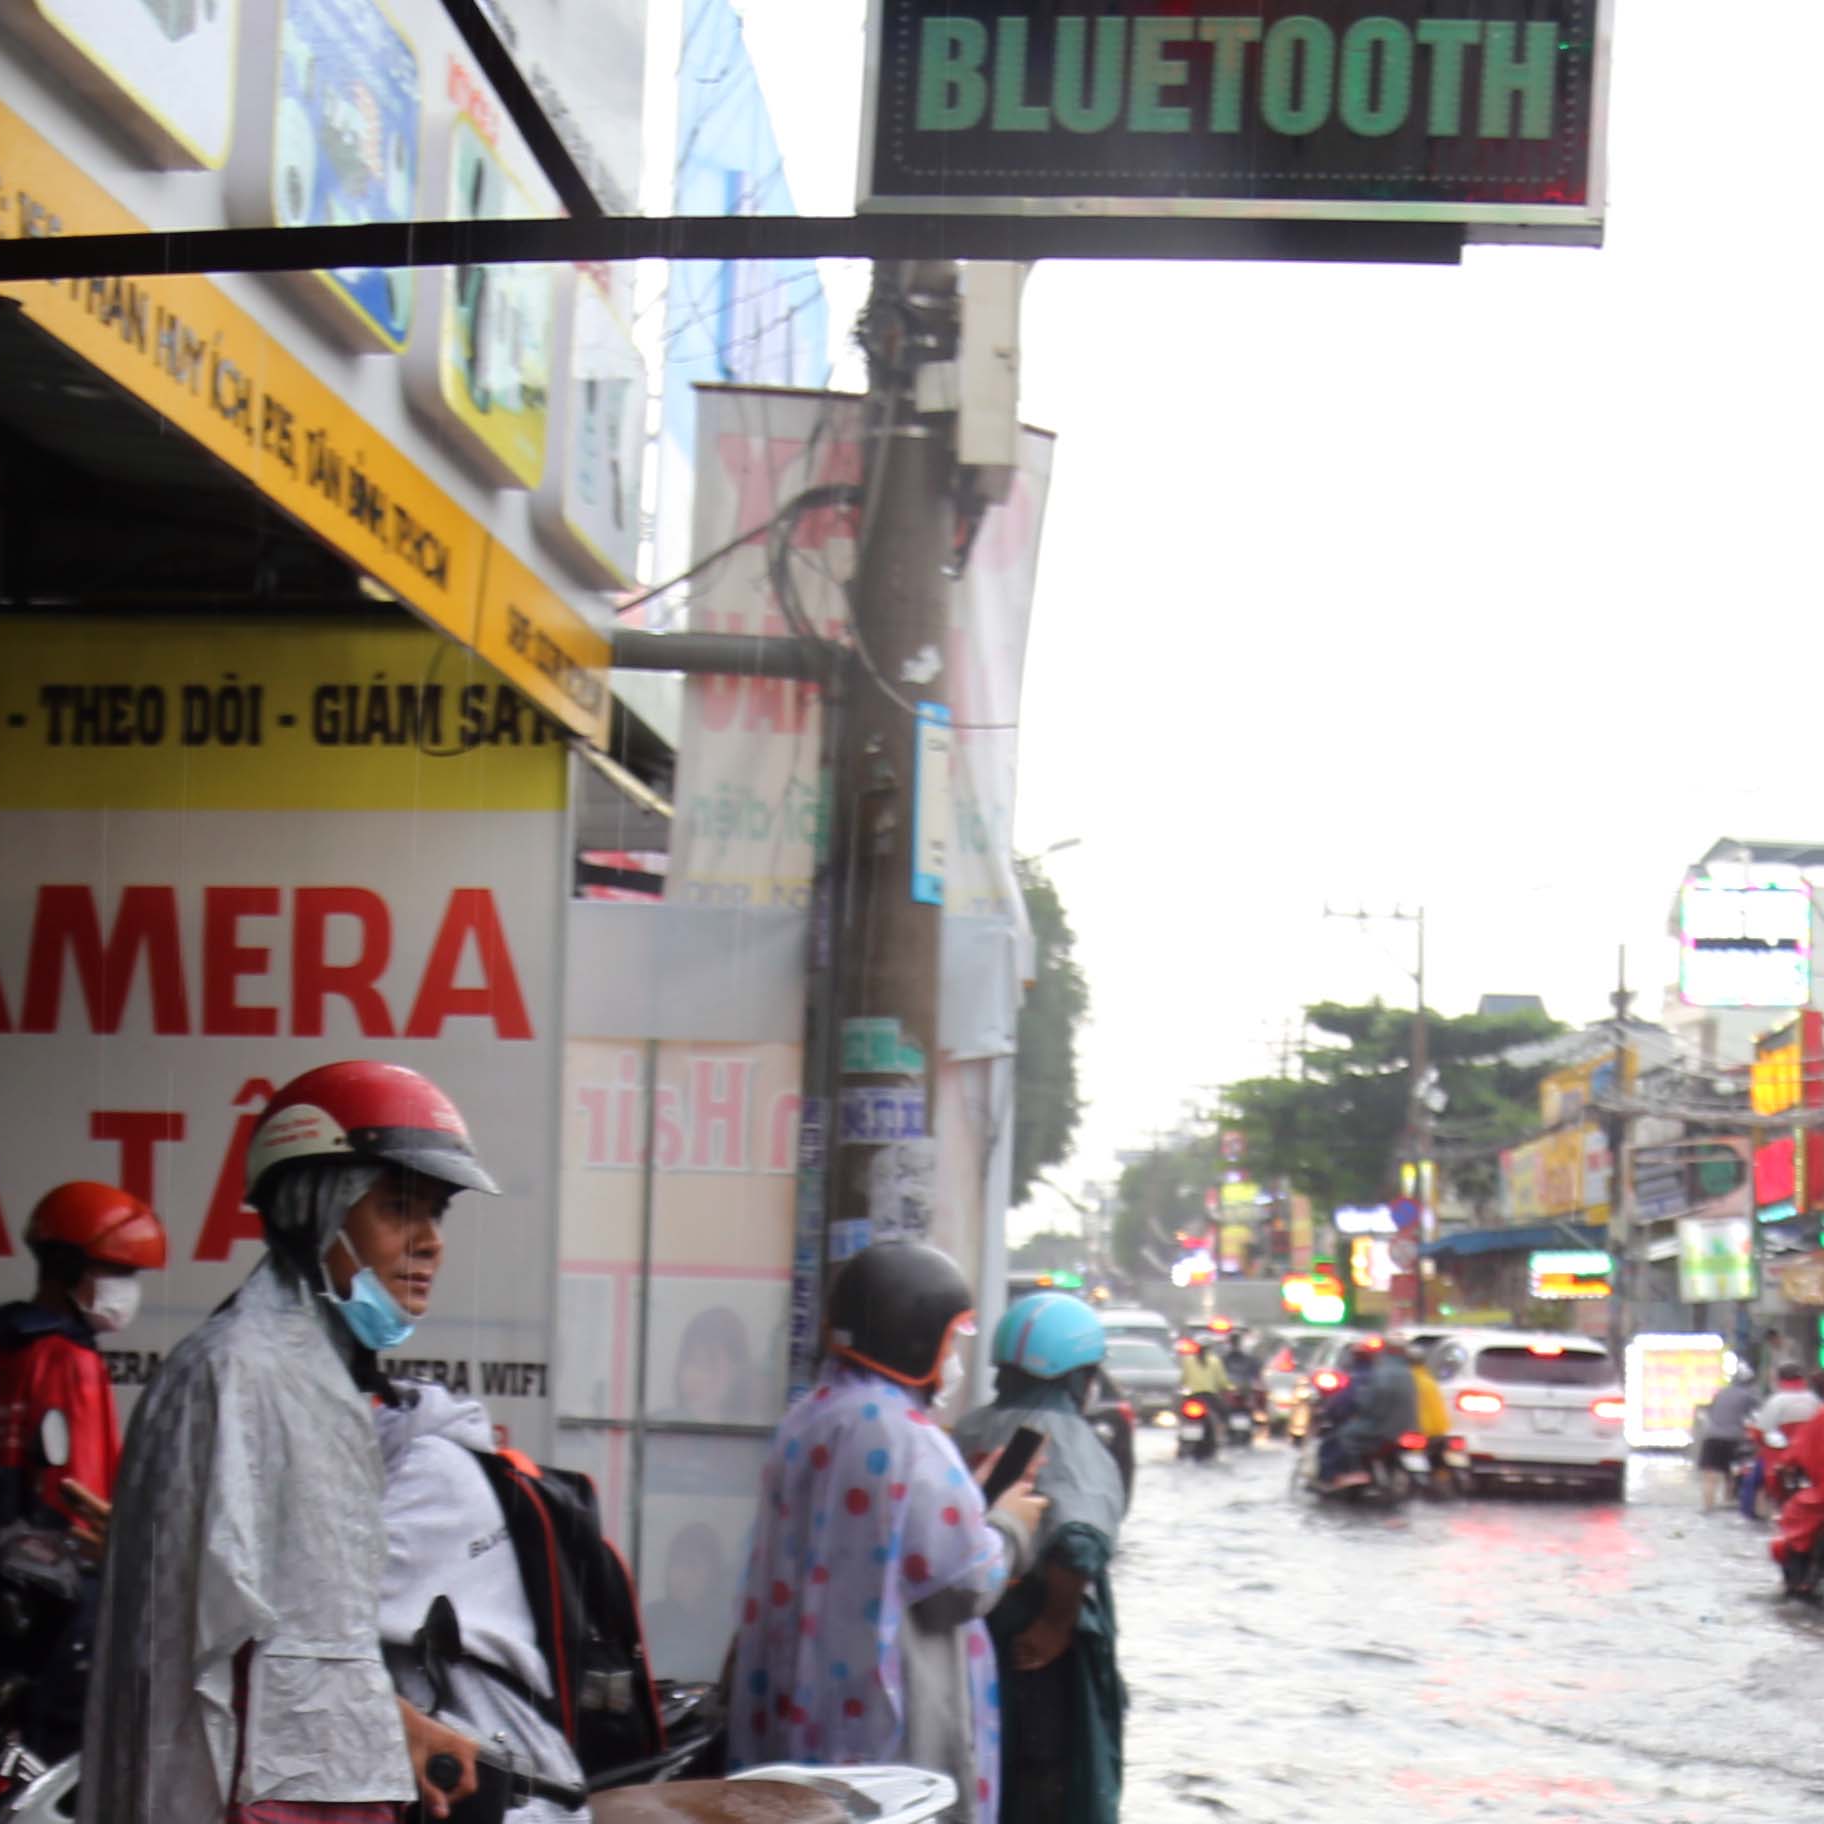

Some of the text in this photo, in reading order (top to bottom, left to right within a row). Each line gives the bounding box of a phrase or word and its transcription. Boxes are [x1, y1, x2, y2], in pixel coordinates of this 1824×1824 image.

[916, 15, 1559, 141] BLUETOOTH
[41, 684, 165, 746] THEO
[88, 1077, 276, 1262] TÂ
[480, 1361, 549, 1398] WIFI
